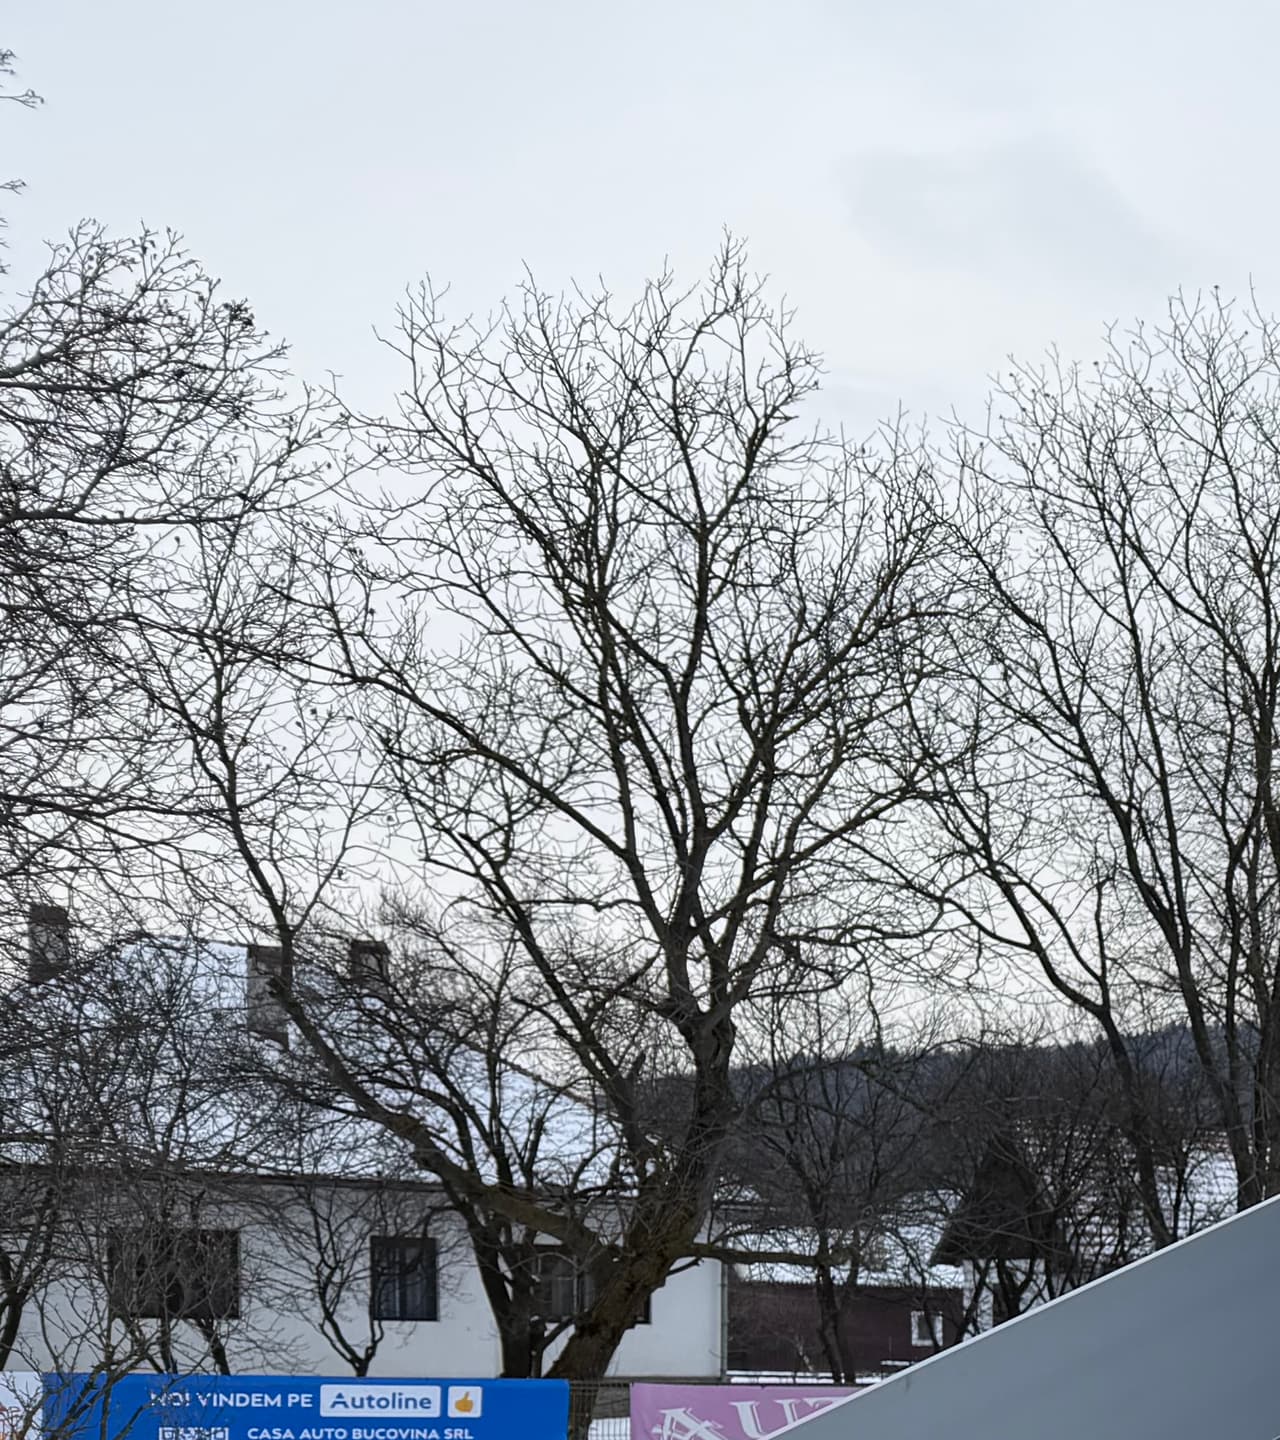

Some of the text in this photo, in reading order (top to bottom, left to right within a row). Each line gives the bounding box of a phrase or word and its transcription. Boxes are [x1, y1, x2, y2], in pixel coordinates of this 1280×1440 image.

[196, 1392, 282, 1408] VINDEM
[287, 1393, 313, 1408] PE
[329, 1392, 432, 1410] Autoline
[247, 1427, 474, 1440] CASA AUTO BUCOVINA SRL
